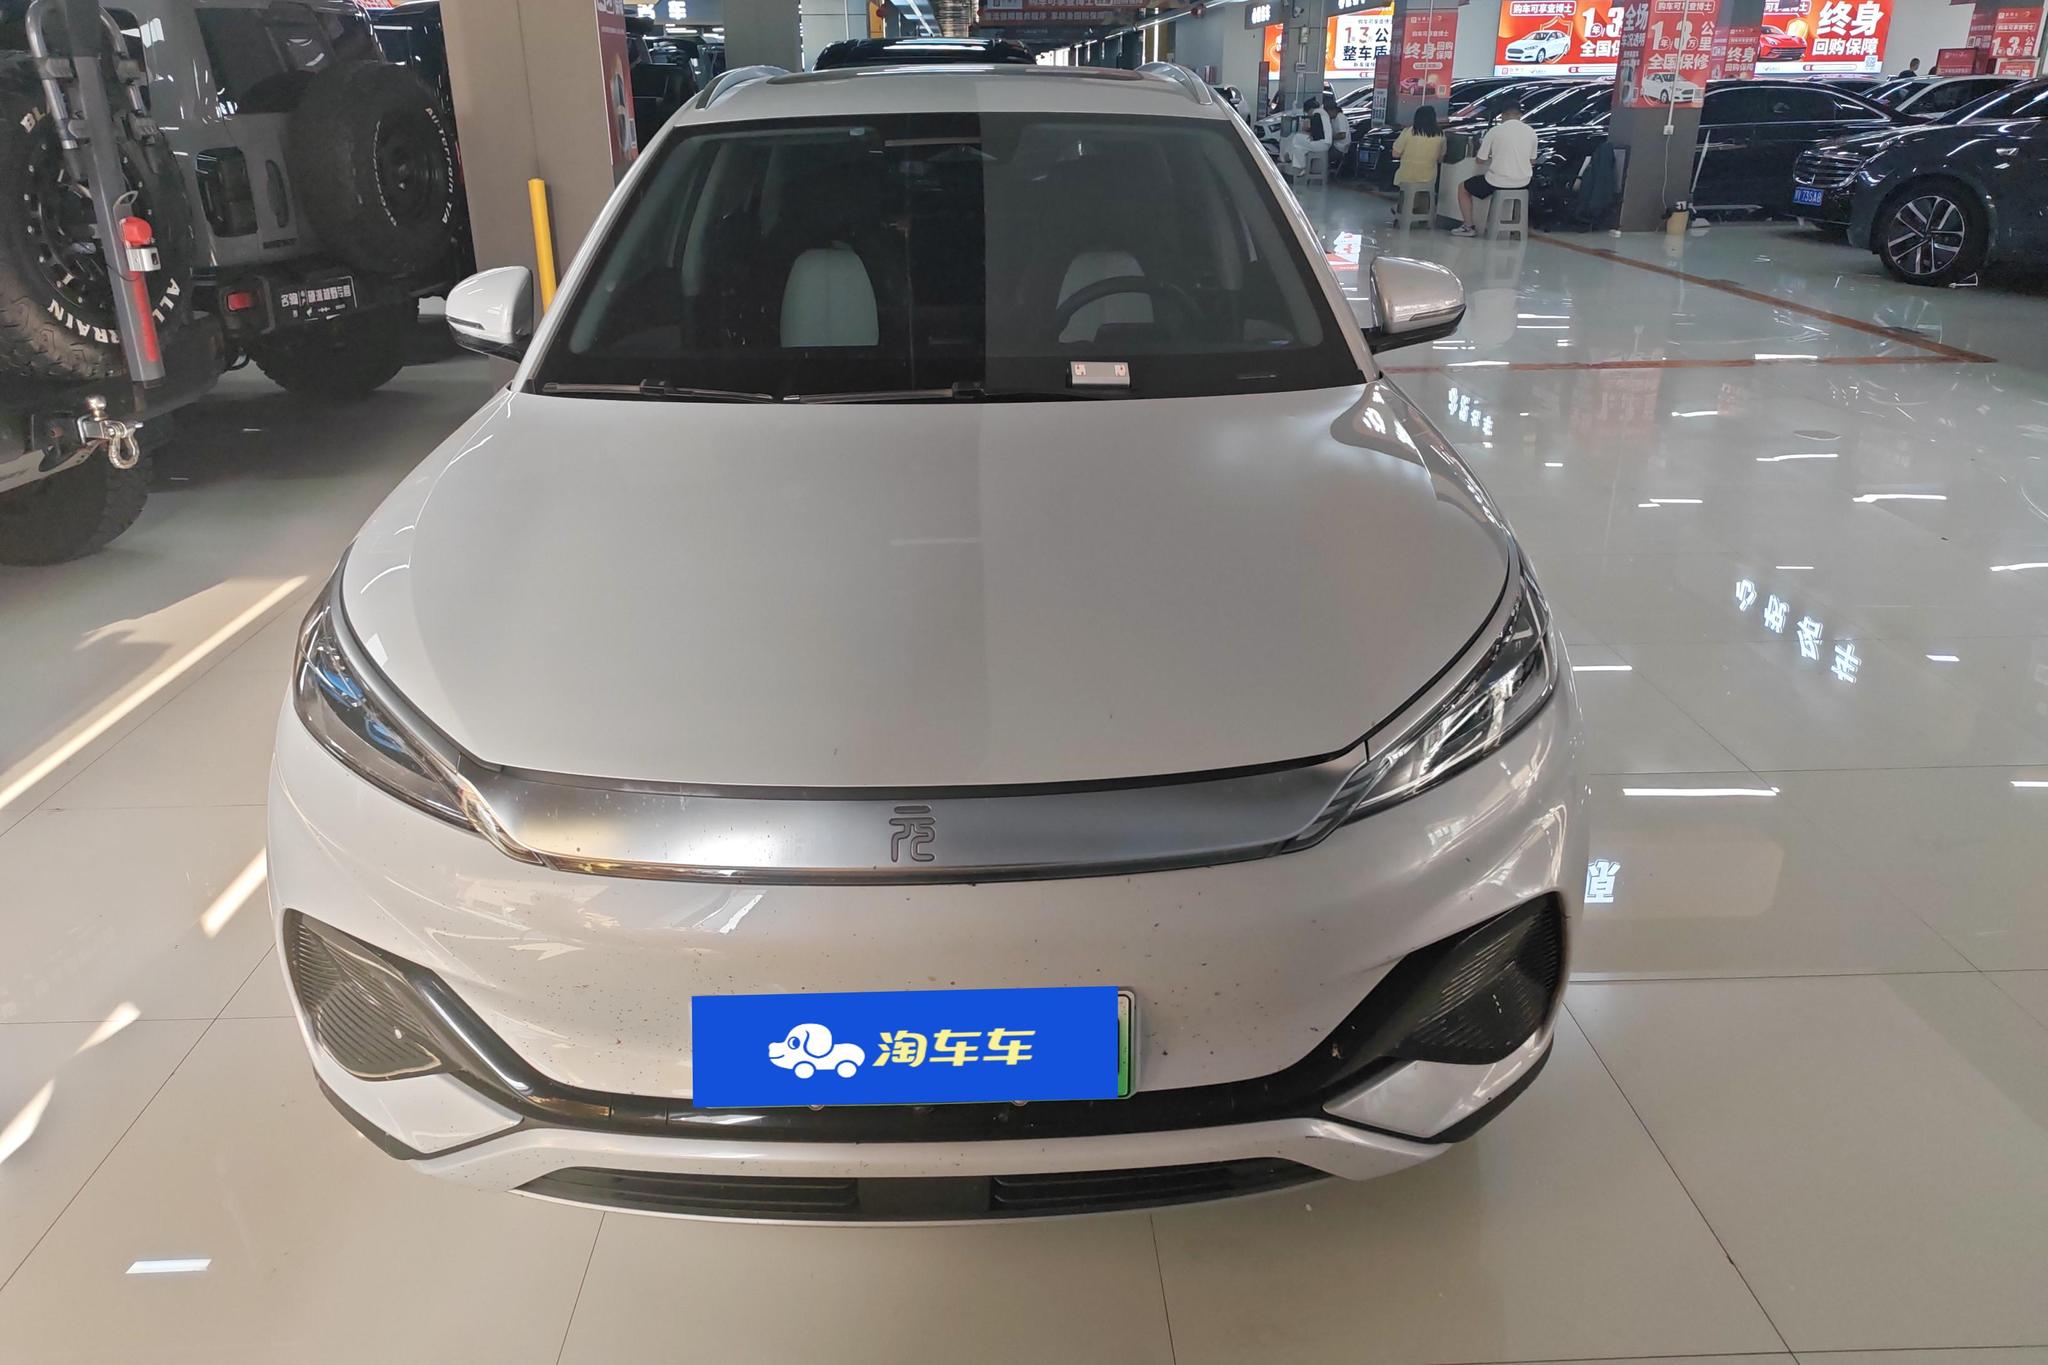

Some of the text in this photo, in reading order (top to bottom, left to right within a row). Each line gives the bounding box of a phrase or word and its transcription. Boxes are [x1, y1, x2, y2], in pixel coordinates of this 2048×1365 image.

[1513, 3, 1573, 14] 购车可享查博士
[1817, 1, 1884, 37] 终身
[1404, 42, 1436, 59] 终身
[1726, 46, 1756, 63] 终身
[1811, 37, 1879, 56] 回购保障
[1647, 53, 1710, 70] 全国保修
